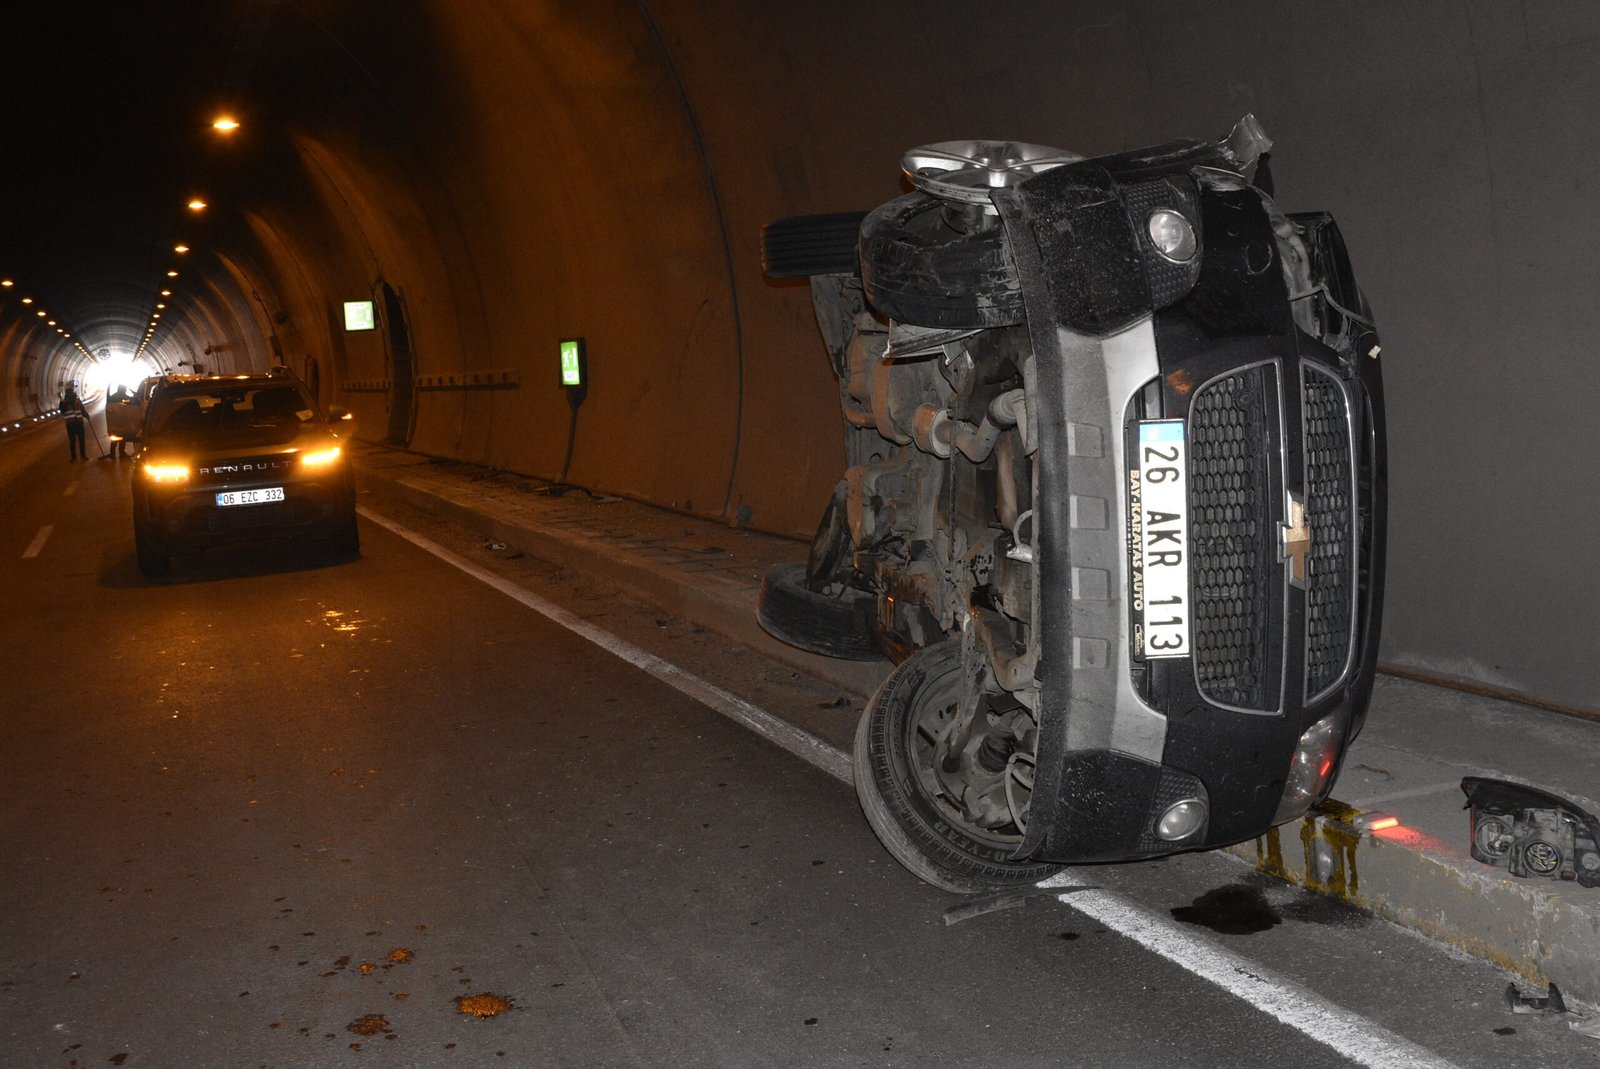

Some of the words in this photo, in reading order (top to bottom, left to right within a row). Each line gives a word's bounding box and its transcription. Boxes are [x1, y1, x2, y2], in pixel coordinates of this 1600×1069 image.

[200, 460, 293, 475] RENAULT
[1145, 446, 1180, 484] 26
[223, 494, 235, 505] 06
[241, 491, 259, 503] EZC
[265, 489, 282, 500] 332
[1147, 510, 1182, 568] AKR
[1133, 571, 1144, 611] AUTO
[1149, 595, 1183, 651] 113
[933, 819, 1009, 864] DYEAR
